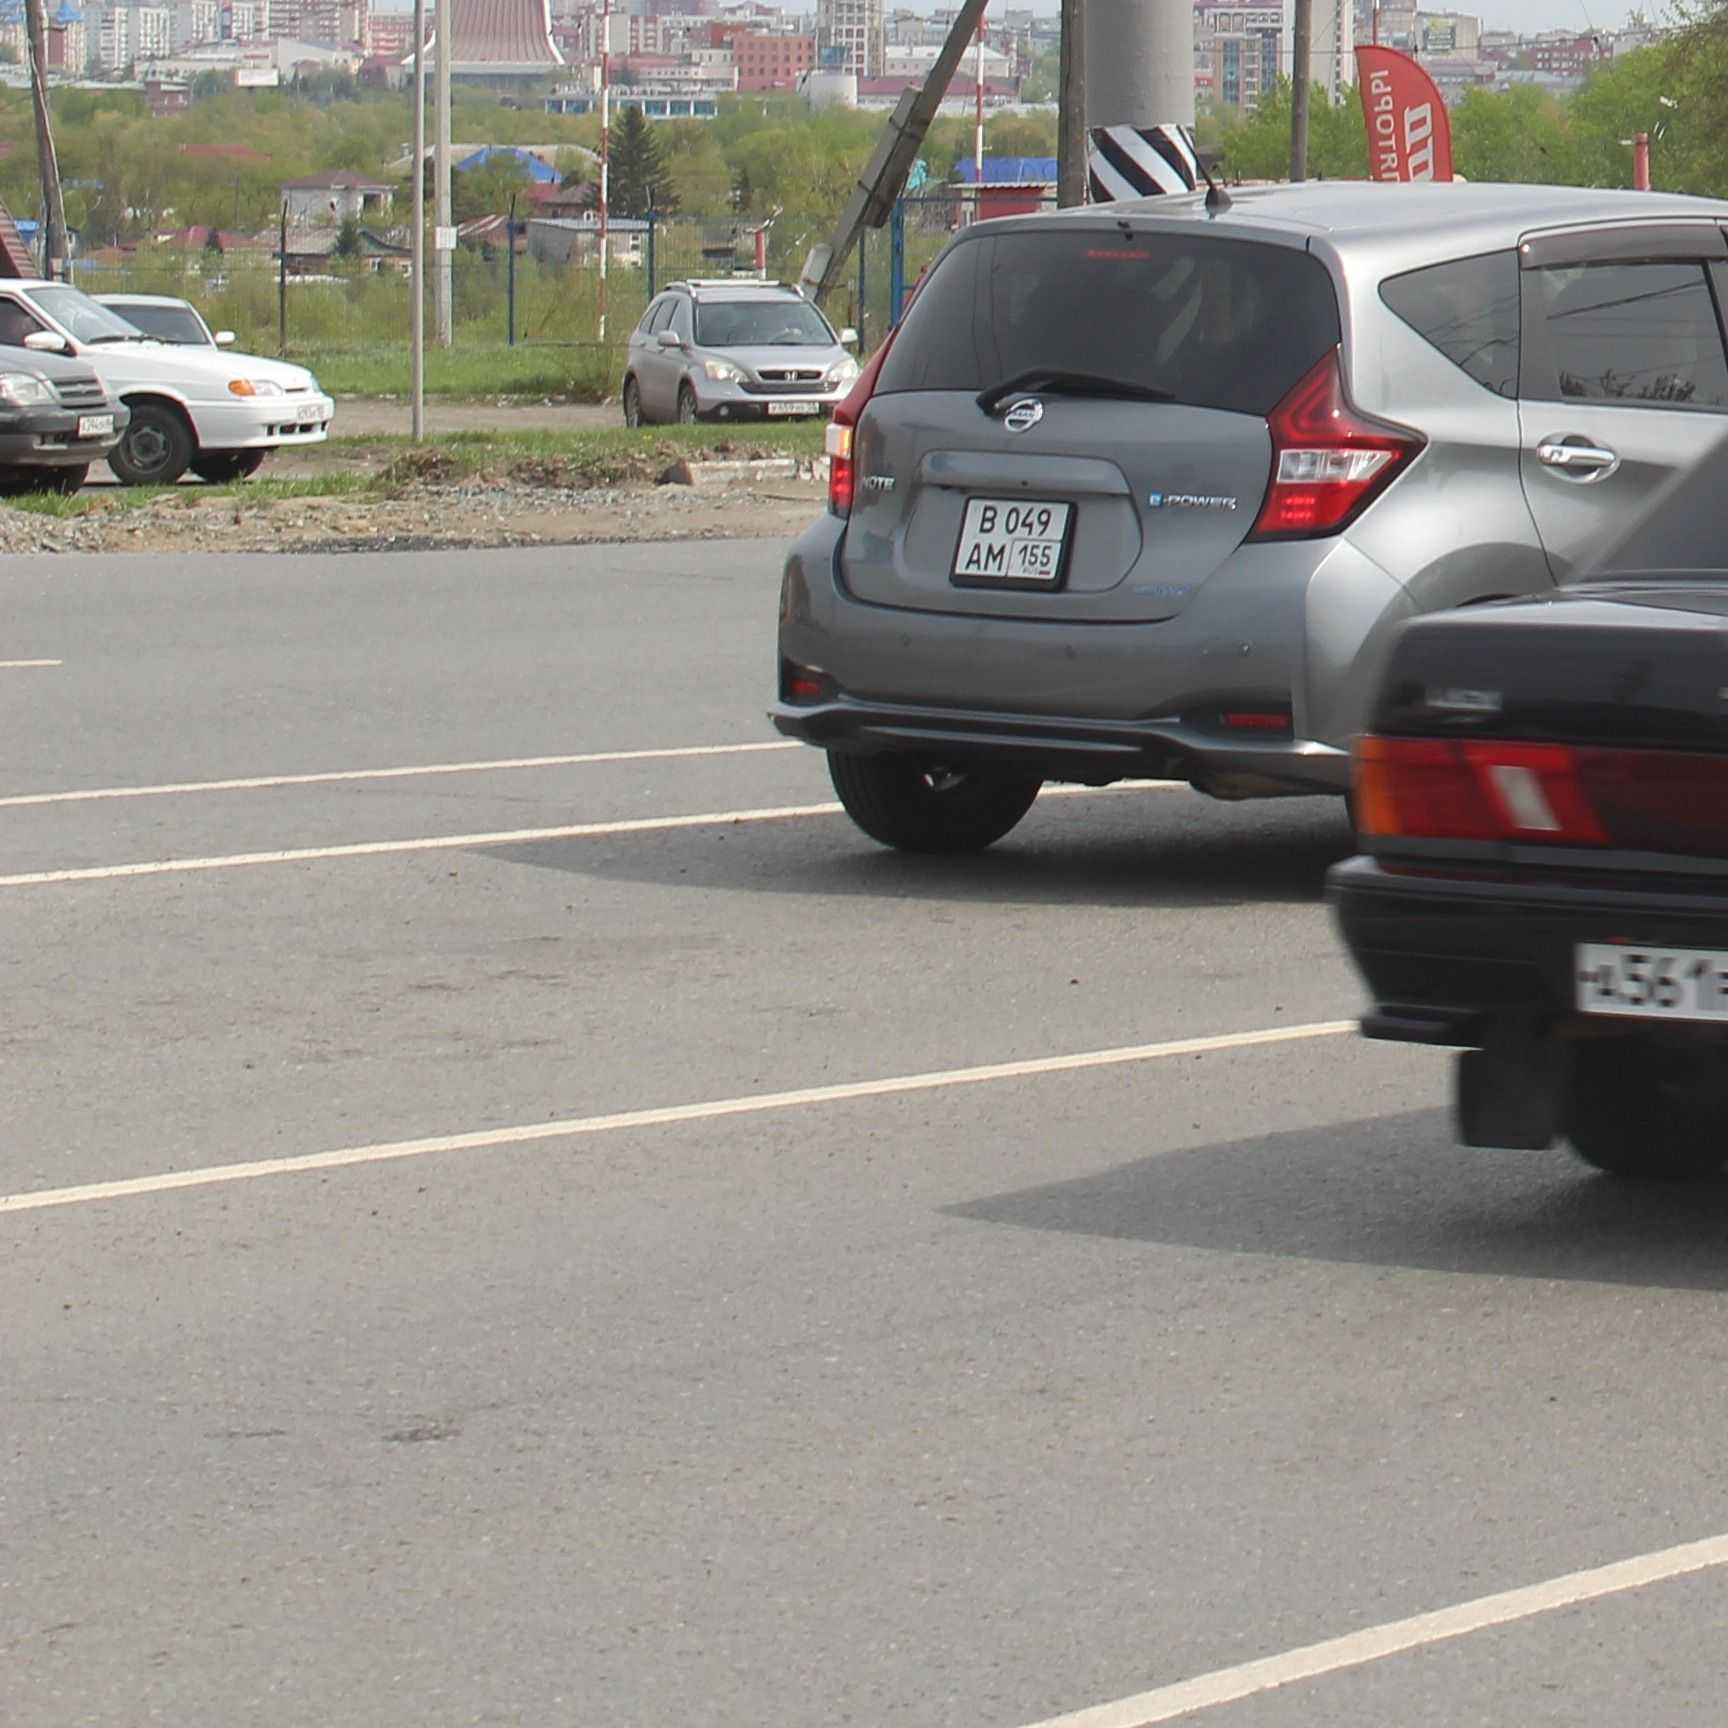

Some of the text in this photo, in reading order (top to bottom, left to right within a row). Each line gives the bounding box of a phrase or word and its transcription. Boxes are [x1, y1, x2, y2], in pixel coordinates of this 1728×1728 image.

[979, 505, 1051, 537] В 049
[964, 542, 1052, 573] АМ 155
